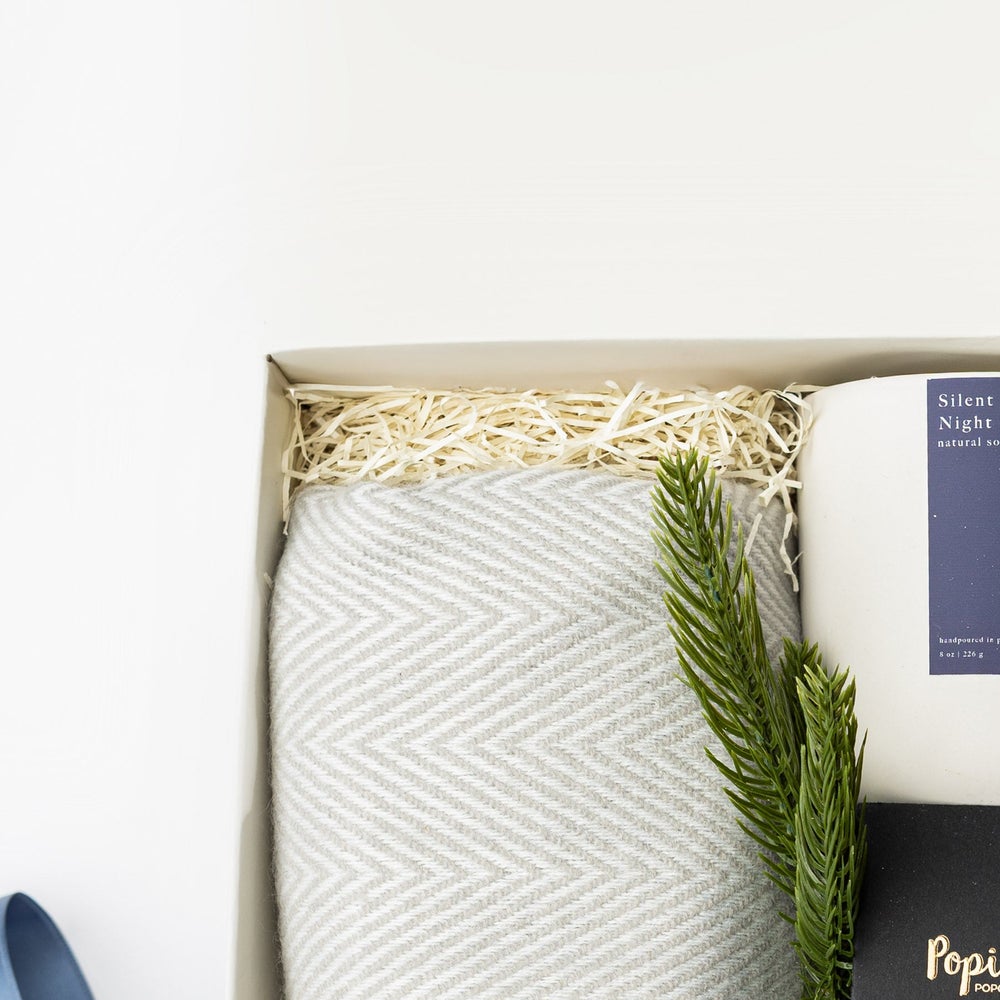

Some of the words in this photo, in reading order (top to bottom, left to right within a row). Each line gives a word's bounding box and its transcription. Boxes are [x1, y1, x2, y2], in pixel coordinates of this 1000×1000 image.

[939, 394, 993, 407] Silent
[939, 416, 993, 433] Night
[938, 437, 980, 447] natural
